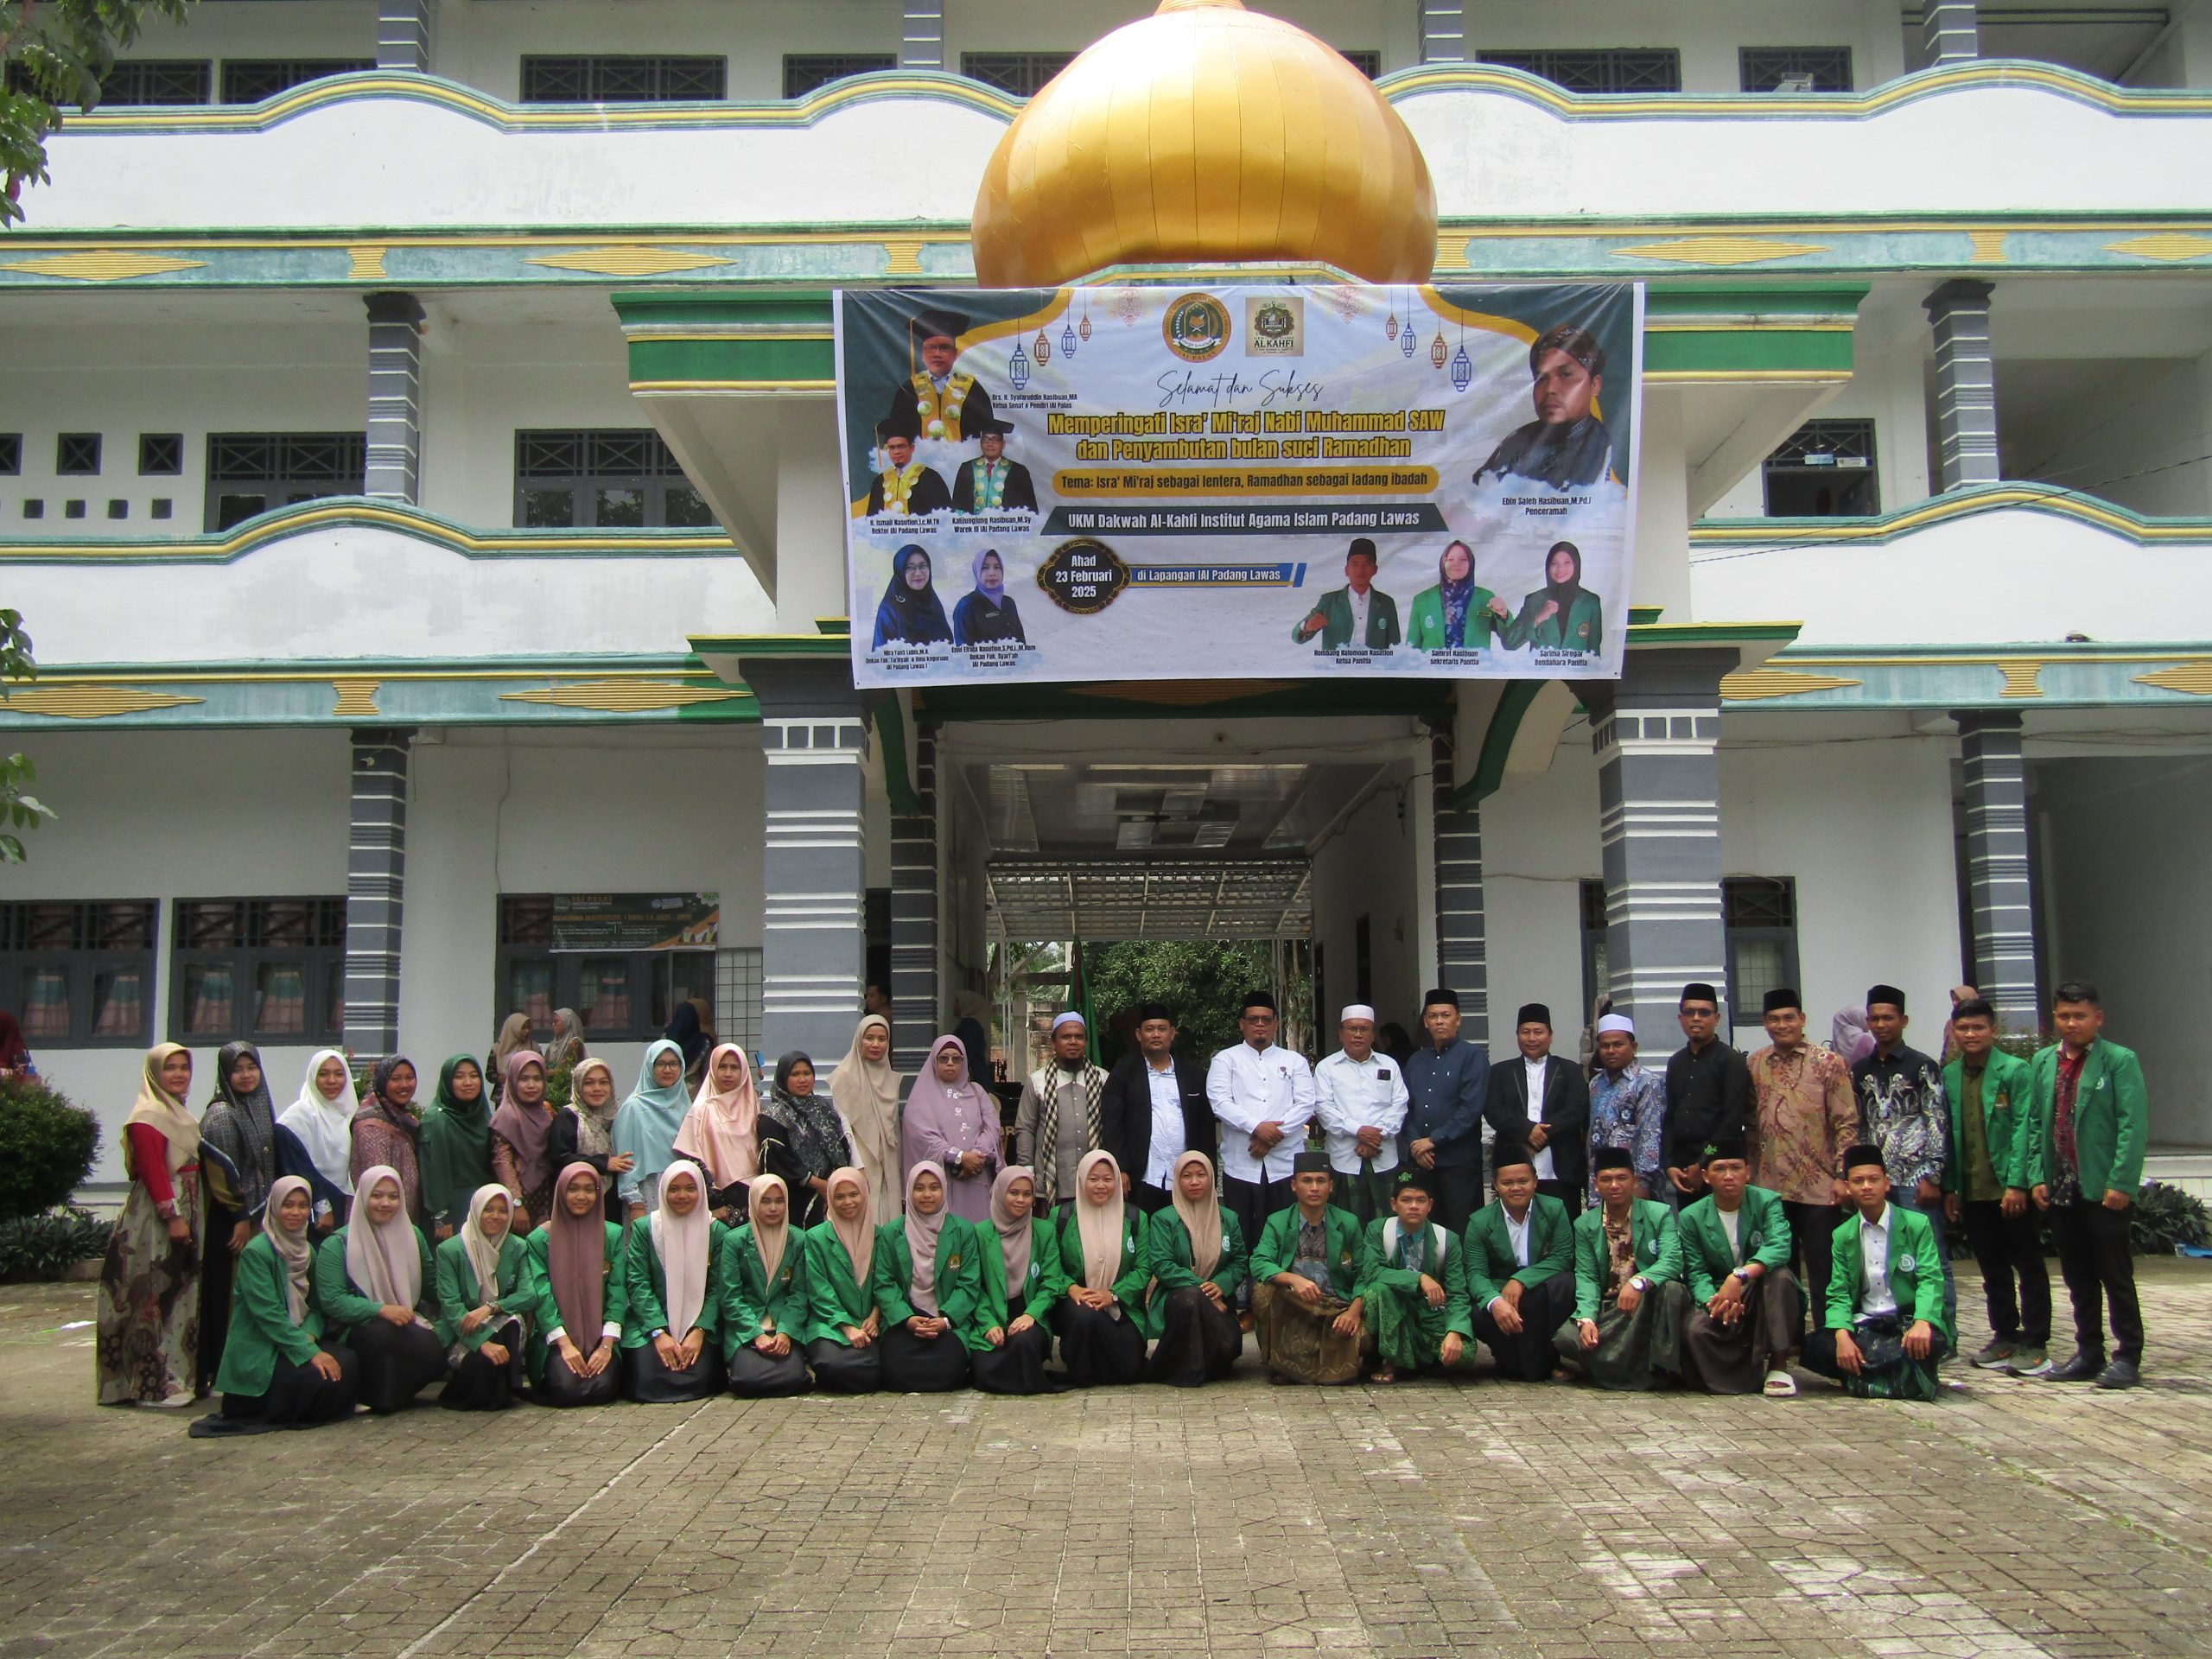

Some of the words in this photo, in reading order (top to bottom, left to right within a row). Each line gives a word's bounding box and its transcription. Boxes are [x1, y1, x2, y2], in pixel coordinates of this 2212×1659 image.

[1254, 340, 1266, 348] AL
[1267, 340, 1294, 348] KAHFI
[1157, 371, 1230, 408] Selamat
[1226, 372, 1253, 404] dan
[1259, 369, 1324, 407] Sukses
[1048, 412, 1166, 436] Memperingati
[1170, 412, 1208, 434] Isra'
[1211, 410, 1262, 435] Mi'raj
[1264, 410, 1302, 433] Nabi
[1305, 410, 1406, 432] Muhammad
[1408, 410, 1446, 431] SAW
[1076, 439, 1109, 461] dan
[1112, 438, 1228, 462] Penyambutan
[1230, 438, 1279, 460] bulan
[1281, 436, 1319, 459] suci
[1322, 436, 1411, 458] Ramadhan
[1062, 476, 1093, 489] Tema:
[1096, 476, 1120, 489] Isra'
[1124, 475, 1154, 490] Mi'raj
[1157, 475, 1199, 490] sebagai
[1202, 475, 1244, 490] lentera,
[1247, 474, 1303, 487] Ramadhan
[1306, 474, 1349, 488] sebagai
[1352, 473, 1389, 487] ladang
[1391, 472, 1427, 486] ibadah
[1502, 497, 1516, 505] Ebin
[1518, 497, 1537, 505] Saleh
[1525, 507, 1567, 516] Penceramah
[1068, 514, 1095, 529] UKM
[1098, 513, 1147, 529] Dakwah
[1150, 513, 1198, 528] Al-Kahfi
[1200, 512, 1246, 528] Institut
[1249, 513, 1291, 530] Agama
[1294, 512, 1329, 527] Islam
[1332, 512, 1377, 528] Padang
[1380, 511, 1421, 526] Lawas
[1071, 555, 1096, 567] Ahad
[1055, 571, 1068, 583] 23
[1071, 569, 1112, 582] Februari
[1137, 570, 1147, 581] di
[1149, 570, 1195, 582] Lapangan
[1198, 570, 1210, 581] IAI
[1212, 570, 1247, 582] Padang
[1250, 569, 1281, 581] Lawas
[1071, 586, 1096, 598] 2025
